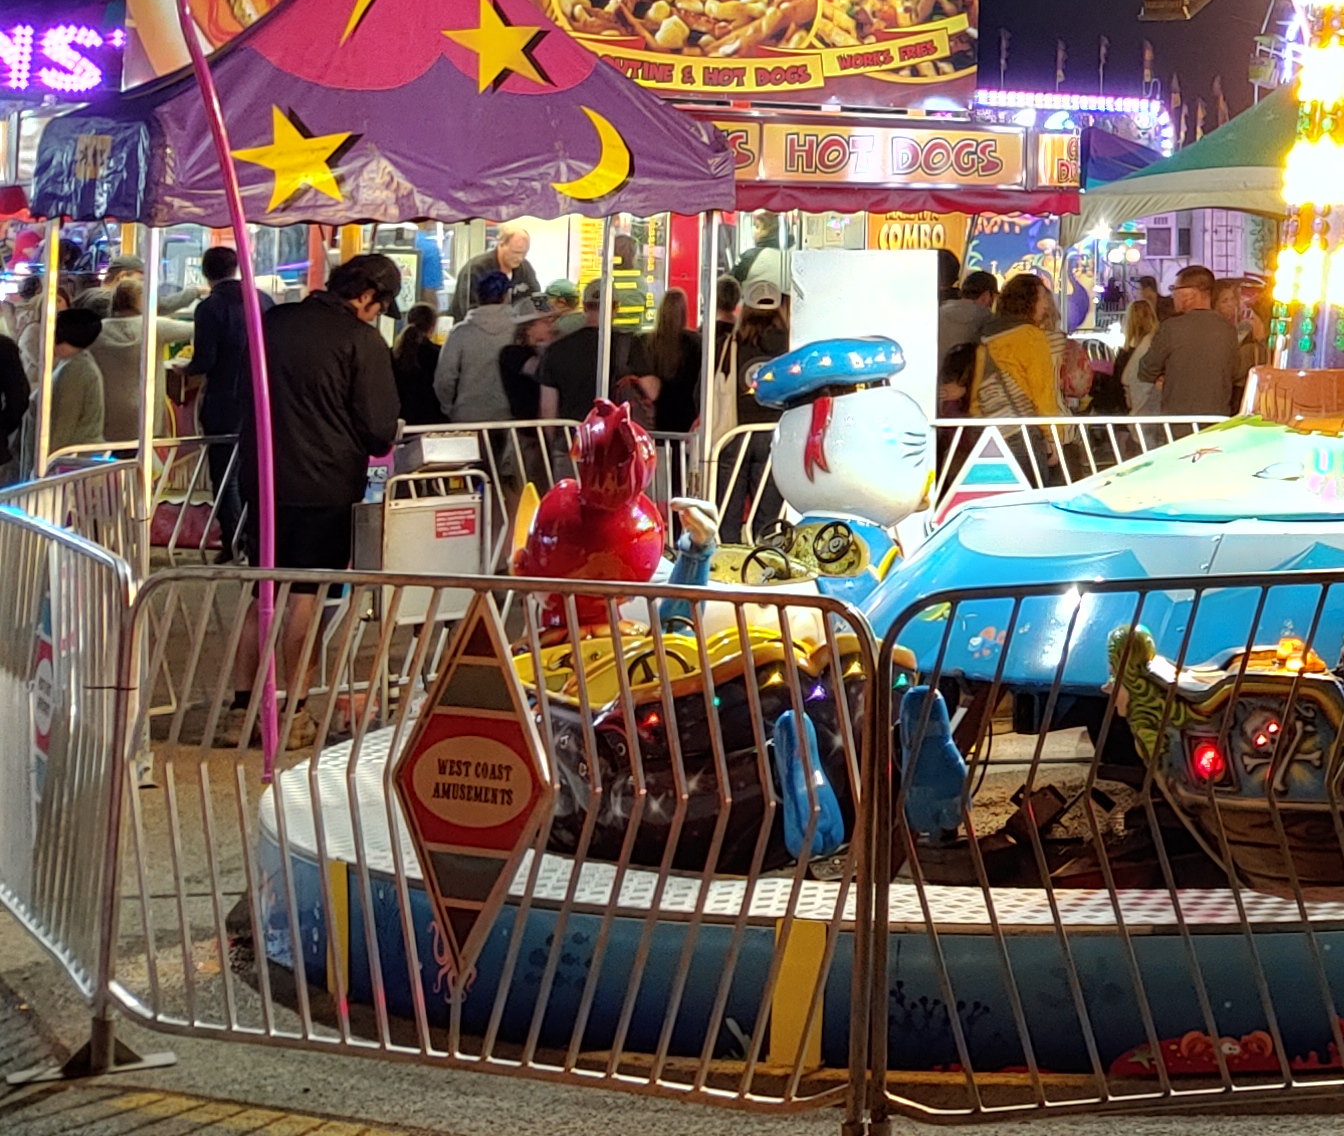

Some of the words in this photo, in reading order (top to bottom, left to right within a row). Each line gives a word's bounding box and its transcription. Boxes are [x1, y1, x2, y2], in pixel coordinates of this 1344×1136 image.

[836, 51, 893, 71] WORKS
[899, 39, 938, 59] FRIES
[681, 66, 696, 85] &
[703, 66, 746, 87] HOT
[755, 66, 812, 87] DOGS
[784, 132, 874, 173] HOT
[892, 137, 1003, 177] DOGS
[877, 223, 945, 250] COMBO
[437, 758, 472, 777] WEST
[474, 761, 513, 782] COAST
[432, 782, 514, 806] AMUSEMENTS
